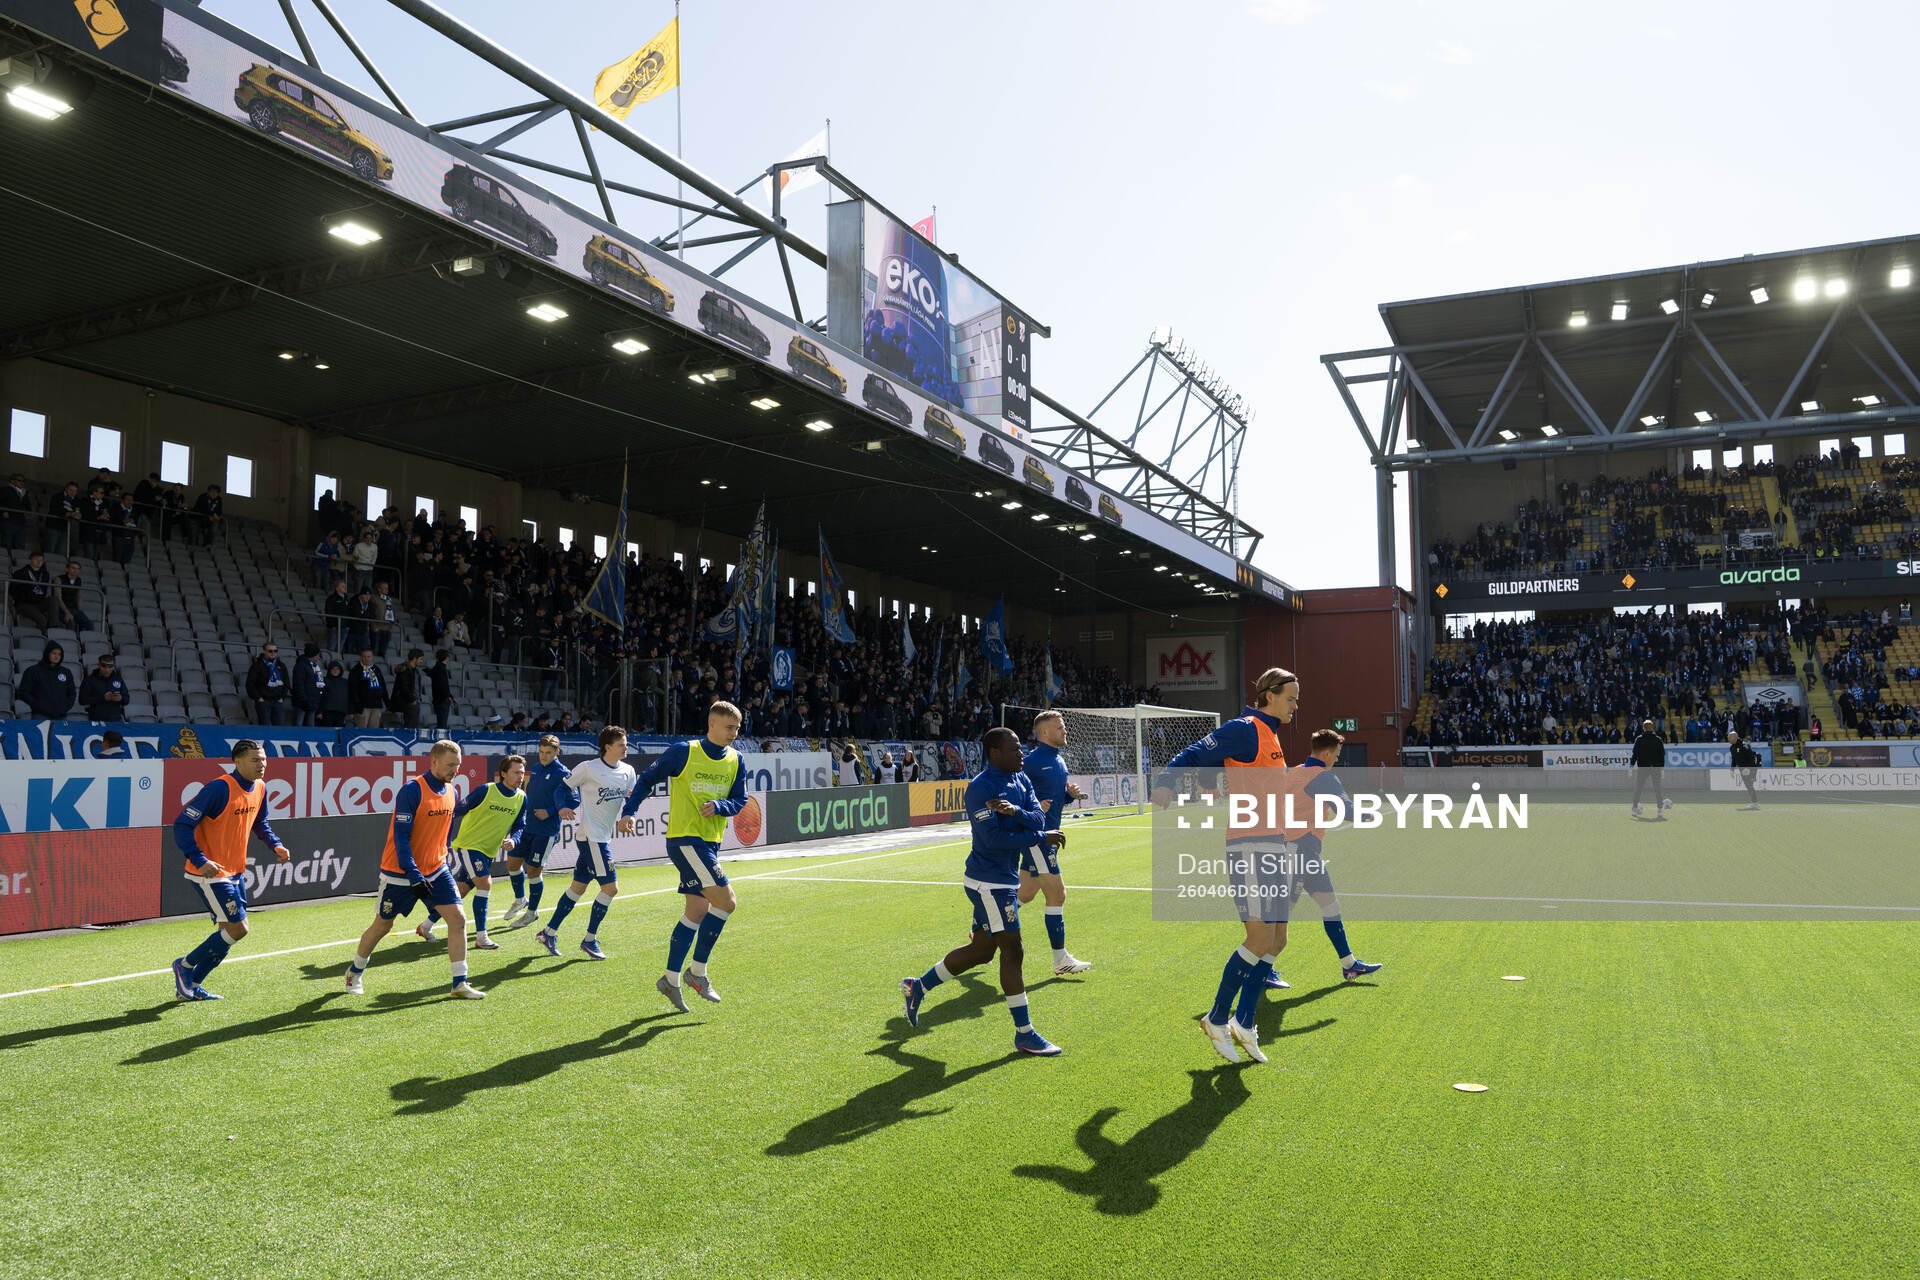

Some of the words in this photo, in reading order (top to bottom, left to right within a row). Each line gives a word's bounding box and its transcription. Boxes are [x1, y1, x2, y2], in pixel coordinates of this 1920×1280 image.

[1007, 376, 1027, 401] 00:00
[1720, 566, 1800, 585] avarda
[1488, 578, 1579, 596] GULDPARTNERS
[1159, 640, 1216, 678] MAX
[695, 772, 724, 781] CRAFT
[0, 776, 132, 833] KI
[489, 804, 513, 815] CRAFT
[797, 789, 889, 834] avarda
